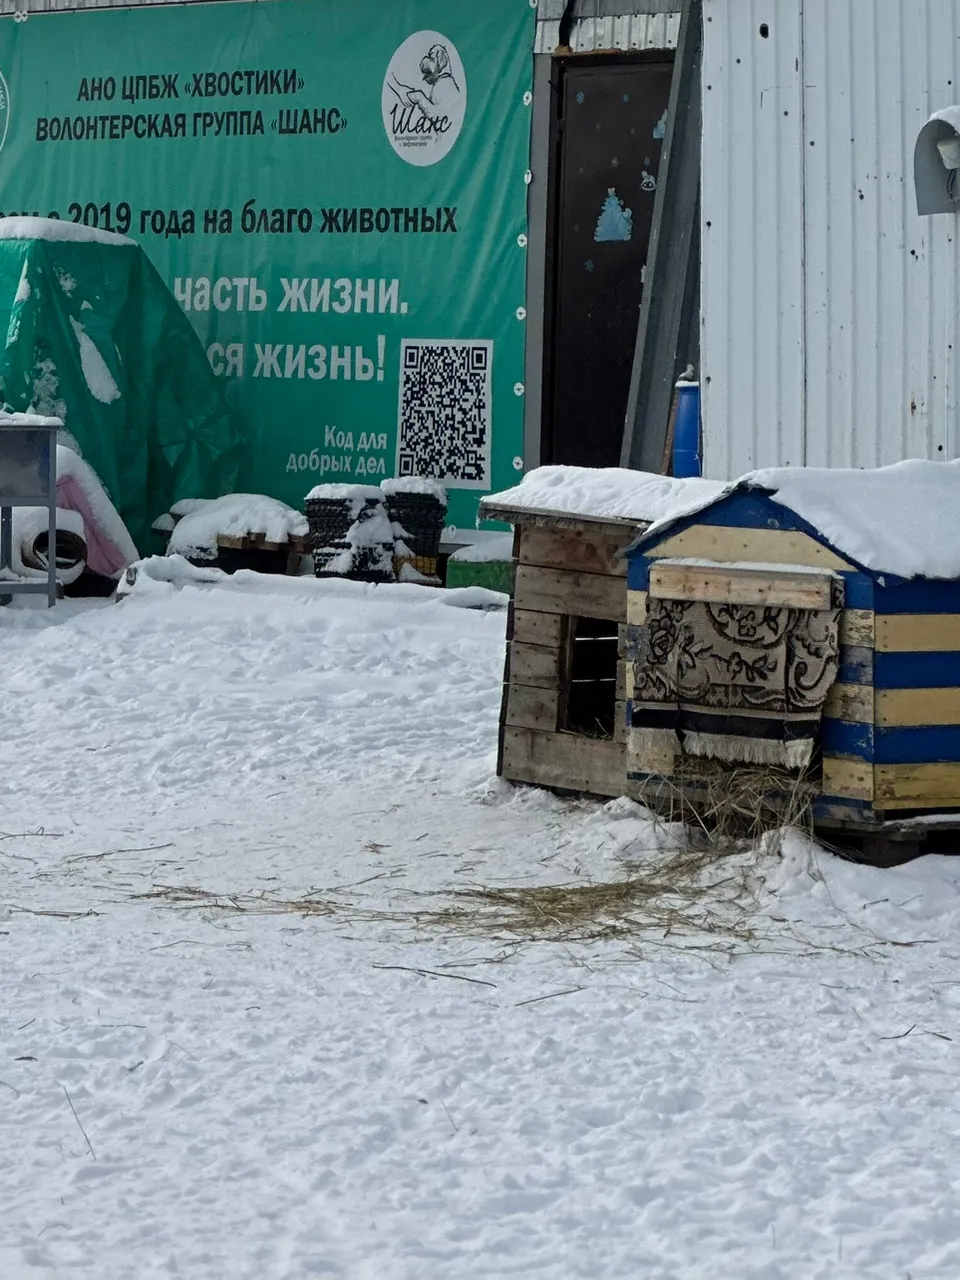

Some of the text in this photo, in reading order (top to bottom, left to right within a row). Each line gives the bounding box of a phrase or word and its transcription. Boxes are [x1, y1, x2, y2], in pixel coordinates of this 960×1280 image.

[77, 69, 305, 104] АНО ЦПБЖ «ХВОСТИКИ»
[36, 108, 348, 141] ВОЛОНТЕРСКАЯ ГРУППА «ШАНС»
[68, 202, 132, 235] 2019
[139, 208, 196, 239] года
[203, 208, 233, 234] на
[241, 198, 313, 234] благо
[319, 207, 458, 234] животных
[174, 276, 268, 312] часть
[276, 277, 409, 314] жизни.
[206, 334, 386, 381] ся жизнь!
[324, 425, 388, 452] Код для
[286, 448, 386, 477] добрых дел
